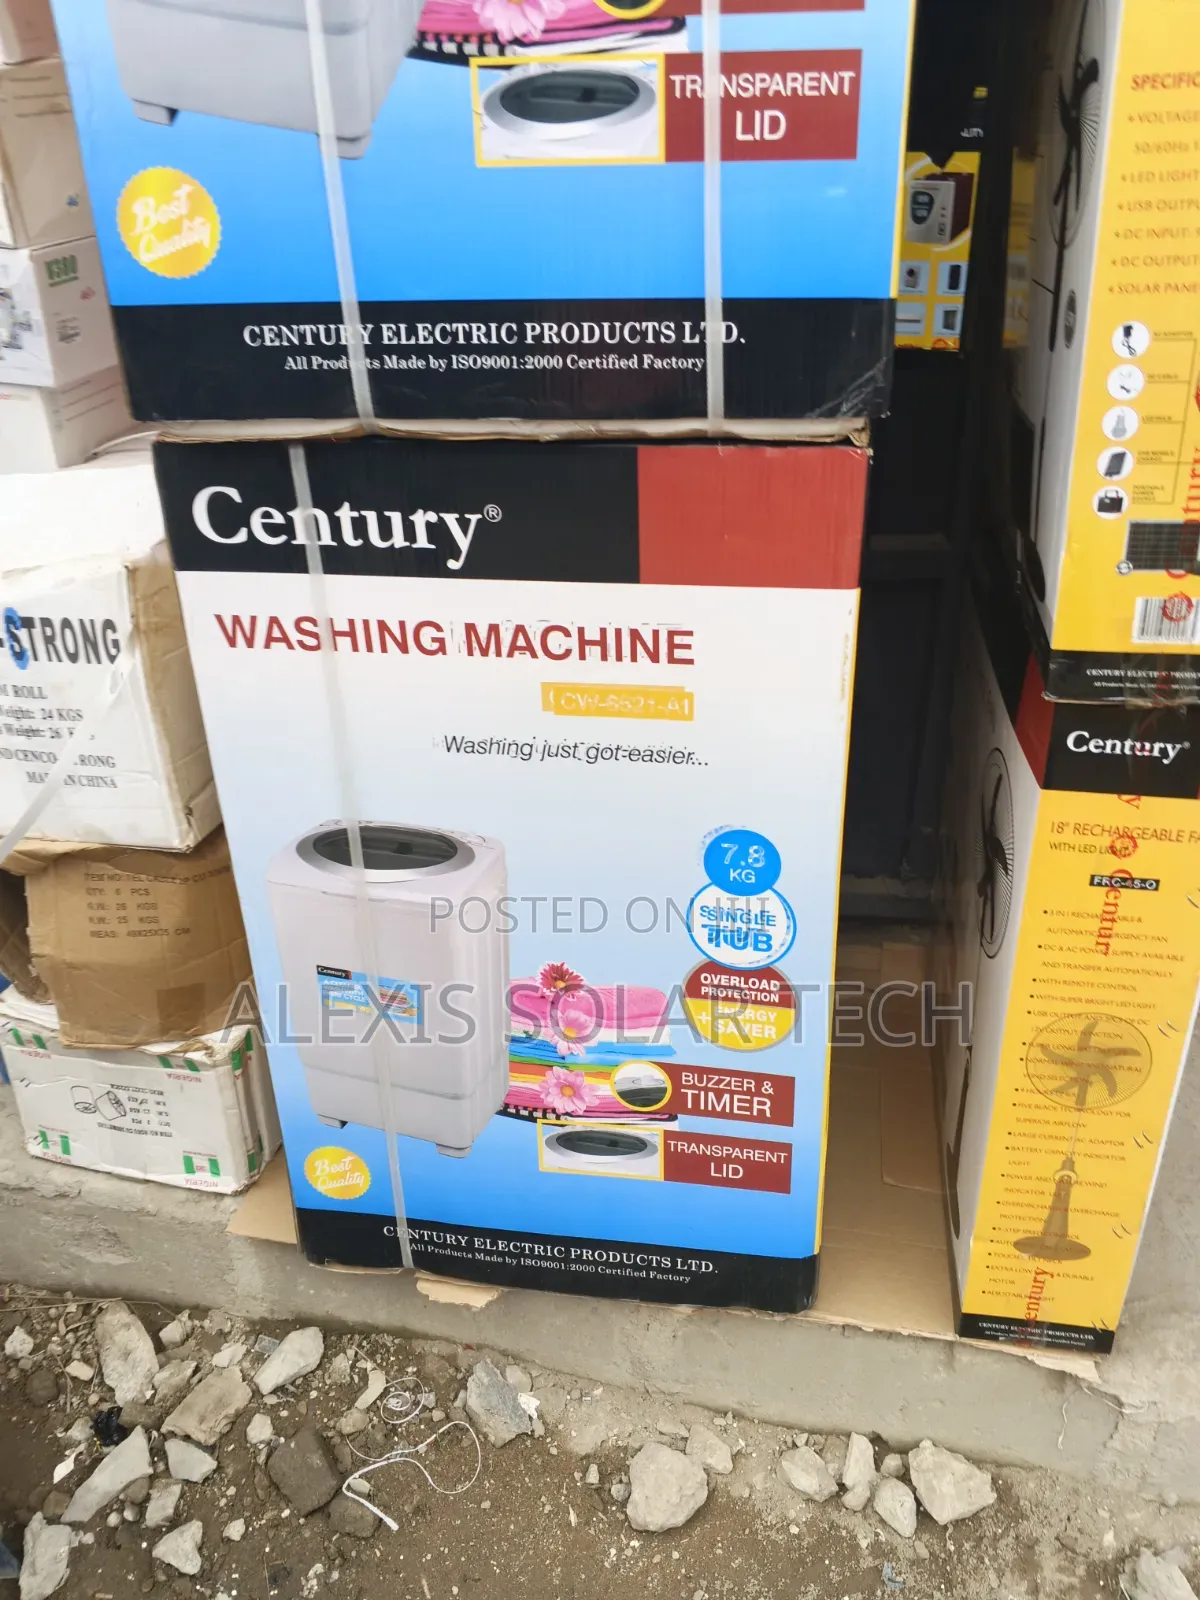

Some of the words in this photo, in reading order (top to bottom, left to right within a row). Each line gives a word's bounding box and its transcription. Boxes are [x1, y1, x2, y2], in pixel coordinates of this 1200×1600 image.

[670, 71, 855, 99] TRNSPARENT
[735, 110, 787, 142] LID
[129, 184, 193, 236] Best
[139, 216, 211, 263] Quality
[380, 322, 518, 345] ELECTRIC
[524, 321, 676, 344] PRODUCTS
[284, 355, 307, 370] All
[311, 355, 381, 370] Prodts
[382, 355, 426, 370] Made
[428, 354, 448, 372] by
[450, 354, 563, 370] ISO9001:2000
[566, 353, 638, 370] Certified
[642, 353, 705, 372] Factory
[214, 612, 448, 656] WASHING
[464, 622, 695, 666] MACHINE
[12, 685, 48, 700] ROLL
[56, 708, 85, 722] KGS
[443, 735, 536, 759] Washing
[540, 739, 578, 762] just
[585, 742, 622, 765] got
[78, 774, 119, 789] CHINA
[1073, 822, 1186, 843] RECHARGEABLE
[720, 842, 766, 868] 7.8
[1048, 841, 1076, 853] WITH
[1078, 844, 1097, 854] LED
[729, 868, 756, 884] KG
[700, 905, 776, 927] SINGLE
[701, 924, 773, 952] TUB
[700, 972, 781, 992] OVERLOAD
[700, 986, 780, 1003] PROTECTION
[715, 1005, 777, 1023] ENERGY
[714, 1020, 777, 1039] SAVER
[681, 1071, 756, 1093] BUZZER
[762, 1081, 775, 1095] &
[681, 1088, 772, 1118] TIMER
[667, 1140, 788, 1164] TRANSPARENT
[313, 1156, 354, 1178] Best
[710, 1162, 744, 1179] LID
[184, 1177, 219, 1187] NIGERIA
[317, 1172, 365, 1192] Quality
[410, 1242, 425, 1252] All
[427, 1245, 472, 1260] Products
[475, 1251, 503, 1263] Made
[505, 1255, 518, 1266] by
[521, 1257, 596, 1274] ISO9001:2000
[598, 1266, 646, 1278] Certified
[650, 1270, 691, 1284] Factory
[474, 1236, 565, 1258] ELECTRIC
[570, 1248, 672, 1268] PRODUCTS
[676, 1257, 719, 1274] LTD.
